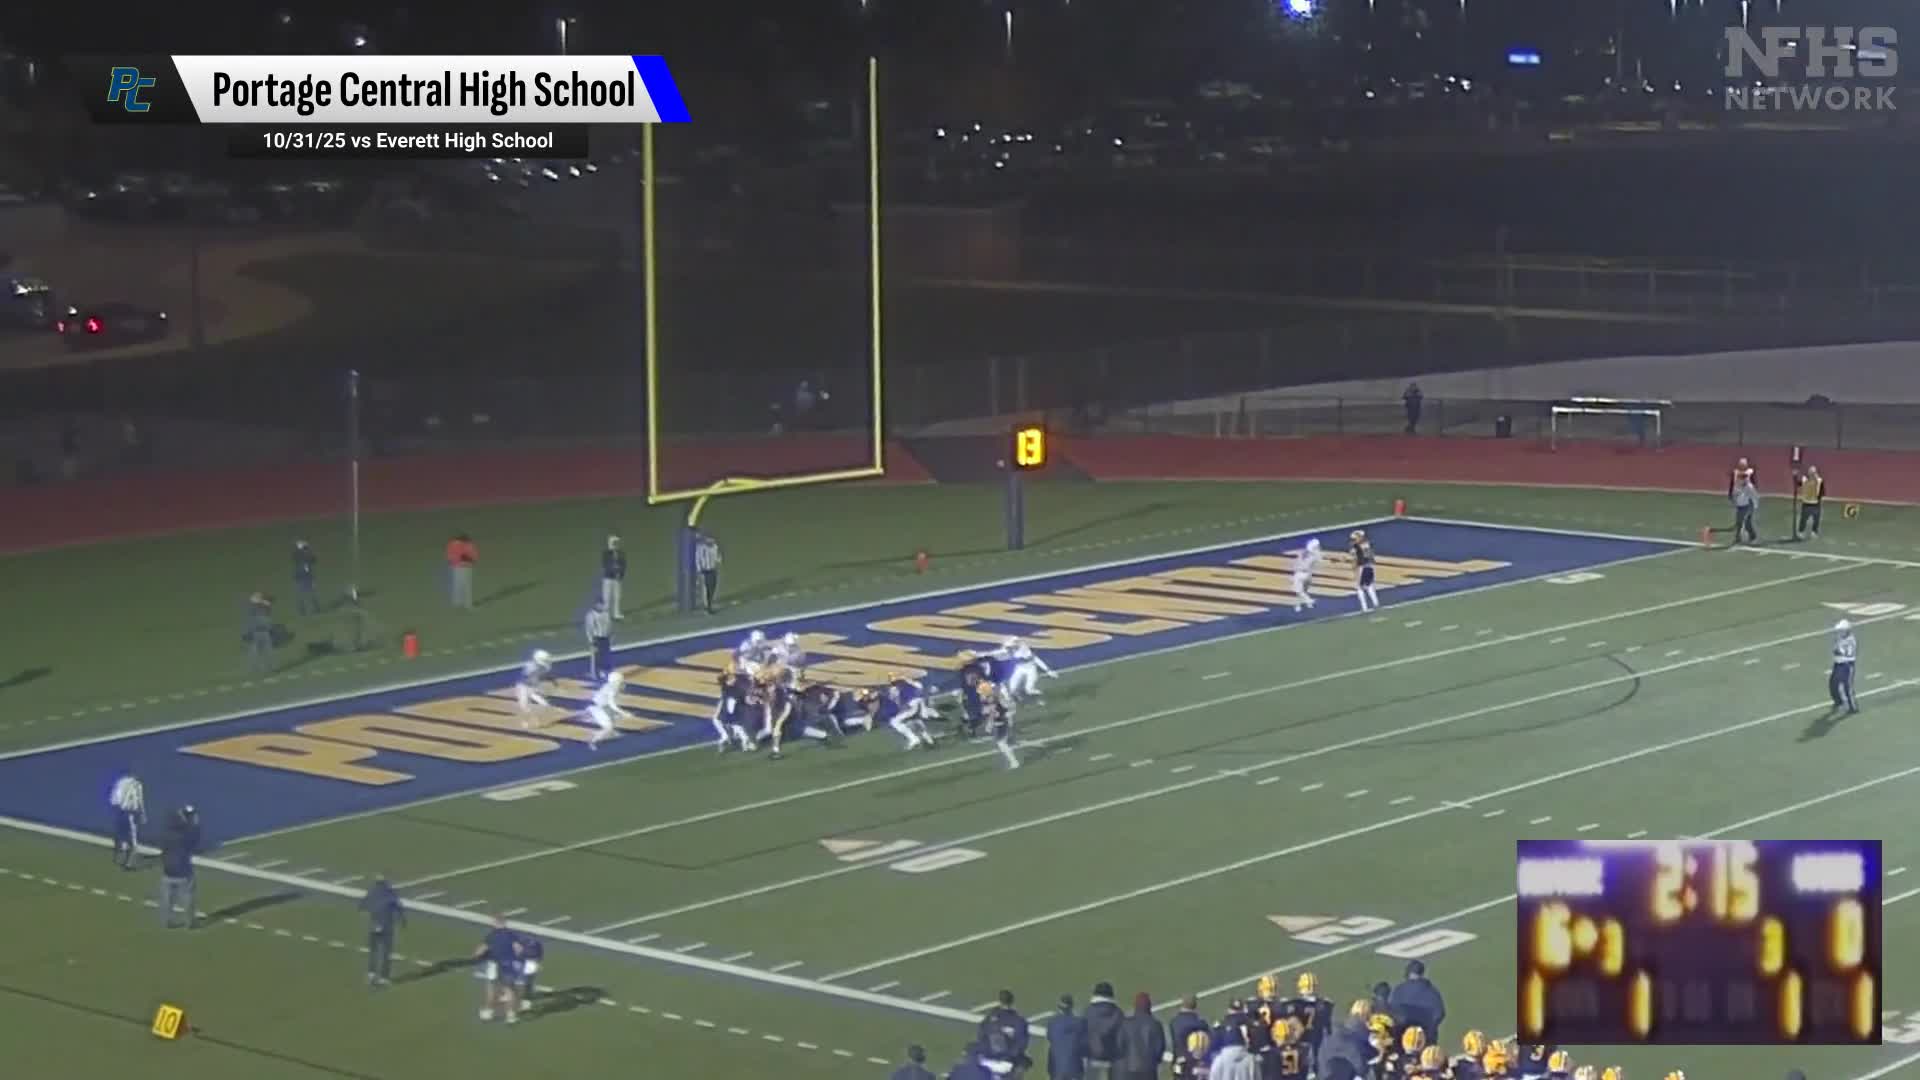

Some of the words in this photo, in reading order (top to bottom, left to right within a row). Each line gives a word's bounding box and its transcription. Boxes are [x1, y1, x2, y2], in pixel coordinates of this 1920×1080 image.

[1017, 428, 1042, 465] 13
[1290, 915, 1478, 959] 20
[156, 1008, 178, 1035] 10
